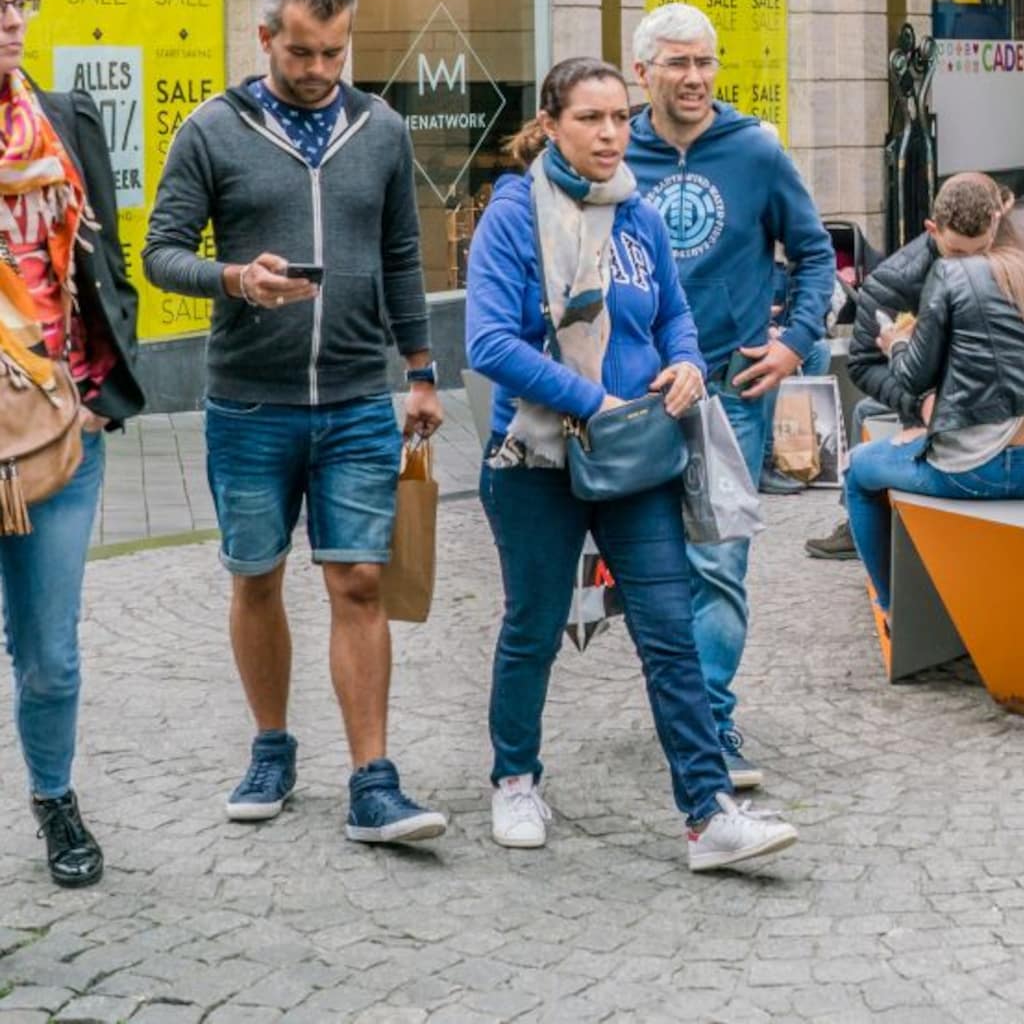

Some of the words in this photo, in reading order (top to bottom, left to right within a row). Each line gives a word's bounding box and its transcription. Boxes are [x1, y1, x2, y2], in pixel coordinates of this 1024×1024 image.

[709, 10, 737, 32] ALE
[74, 61, 132, 91] ALLES
[156, 79, 213, 104] SALE
[716, 84, 740, 104] ALE
[752, 84, 781, 103] SALE
[115, 168, 142, 190] EER
